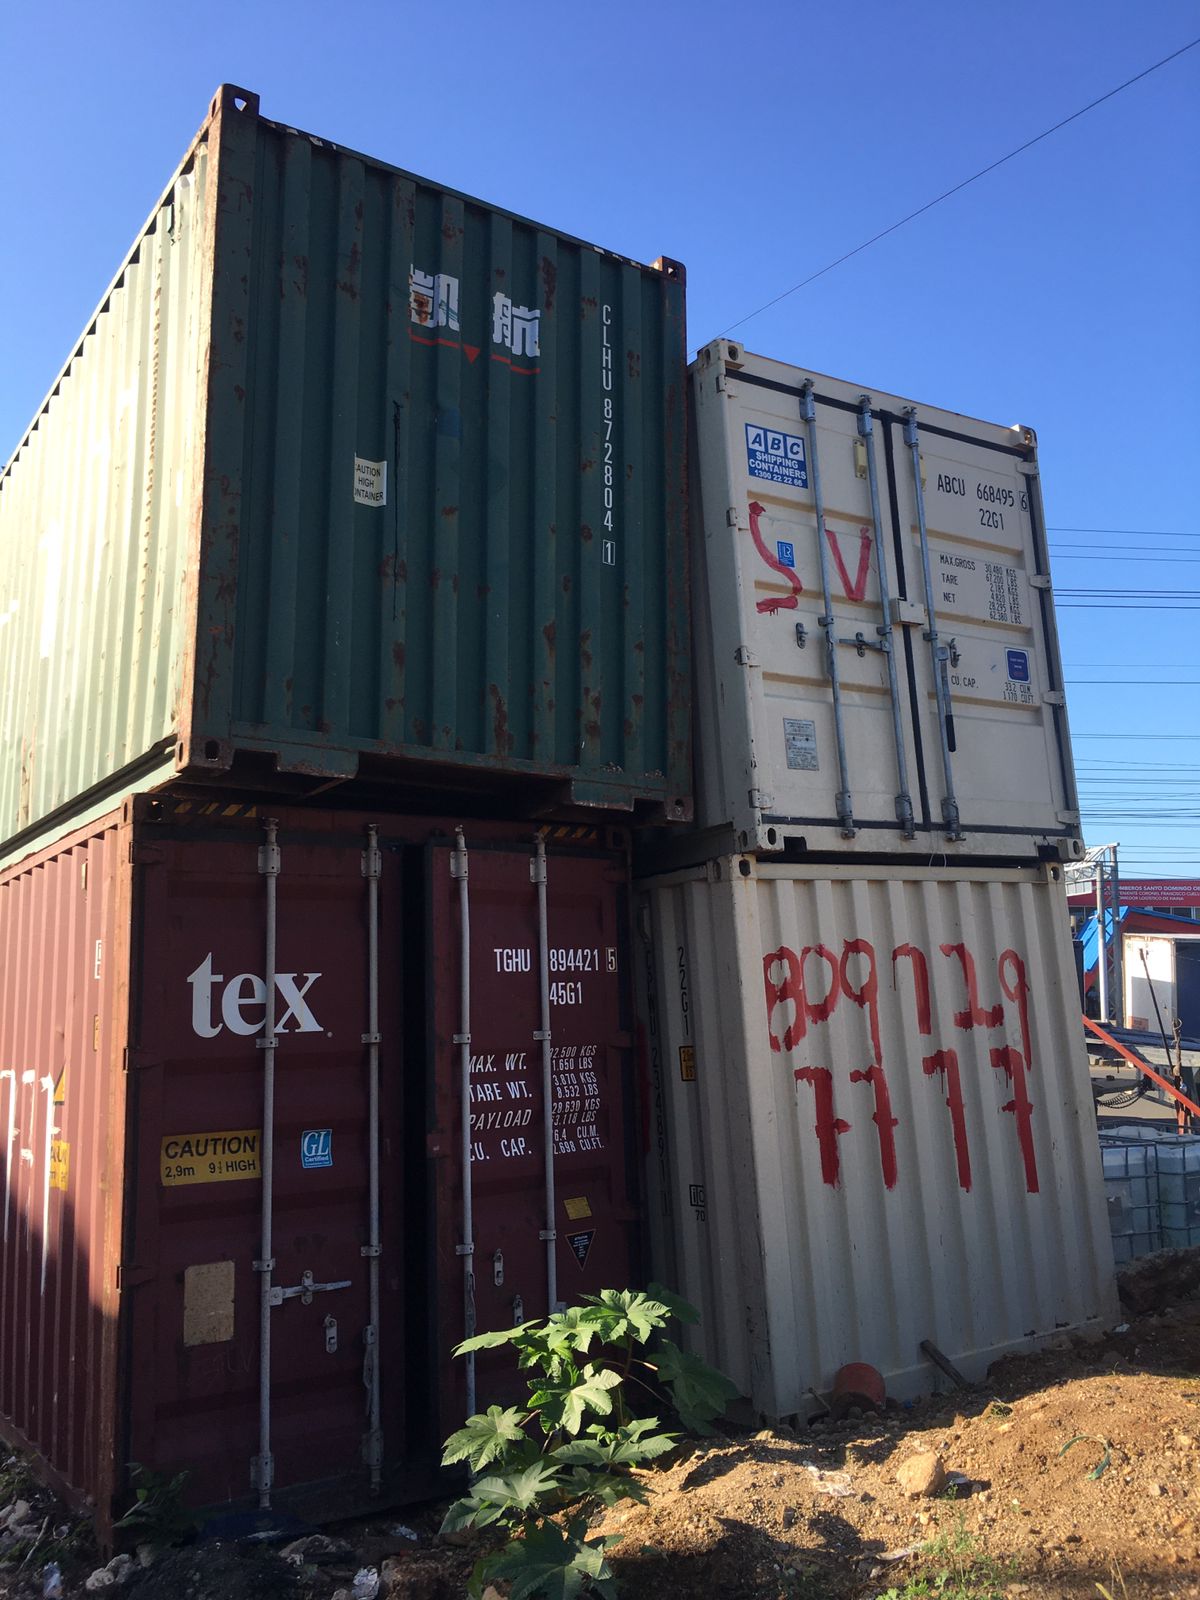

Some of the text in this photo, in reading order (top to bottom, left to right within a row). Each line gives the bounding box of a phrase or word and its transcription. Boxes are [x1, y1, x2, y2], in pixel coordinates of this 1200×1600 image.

[602, 304, 612, 391] CLHU
[751, 432, 801, 456] ABC
[355, 463, 381, 478] AUTION
[603, 398, 614, 532] 872804
[749, 458, 807, 480] CONTAINERS
[755, 451, 799, 469] SHIPPING
[358, 475, 375, 489] HIGH
[754, 469, 772, 480] 1300
[937, 473, 966, 497] ABCU
[976, 482, 1015, 508] 668495
[979, 508, 1005, 531] 22G1
[941, 572, 959, 586] TARE
[942, 591, 956, 603] NET
[493, 947, 617, 973] TGHU 894421 5
[549, 981, 583, 1006] 45G1
[504, 1052, 528, 1071] WT.
[580, 1044, 598, 1057] KGS
[578, 1056, 594, 1070] LBS
[505, 1080, 533, 1100] WT.
[552, 1072, 578, 1086] 3.870
[579, 1071, 598, 1084] KGS
[556, 1083, 600, 1099] 8.532 LBS
[469, 1108, 533, 1131] PAYLOAD
[584, 1097, 601, 1112] KGS
[551, 1110, 597, 1127] 3.118 LBS
[164, 1135, 257, 1160] CAUTION
[303, 1130, 330, 1157] GL
[500, 1136, 533, 1158] CAP.
[225, 1159, 257, 1173] HIGH
